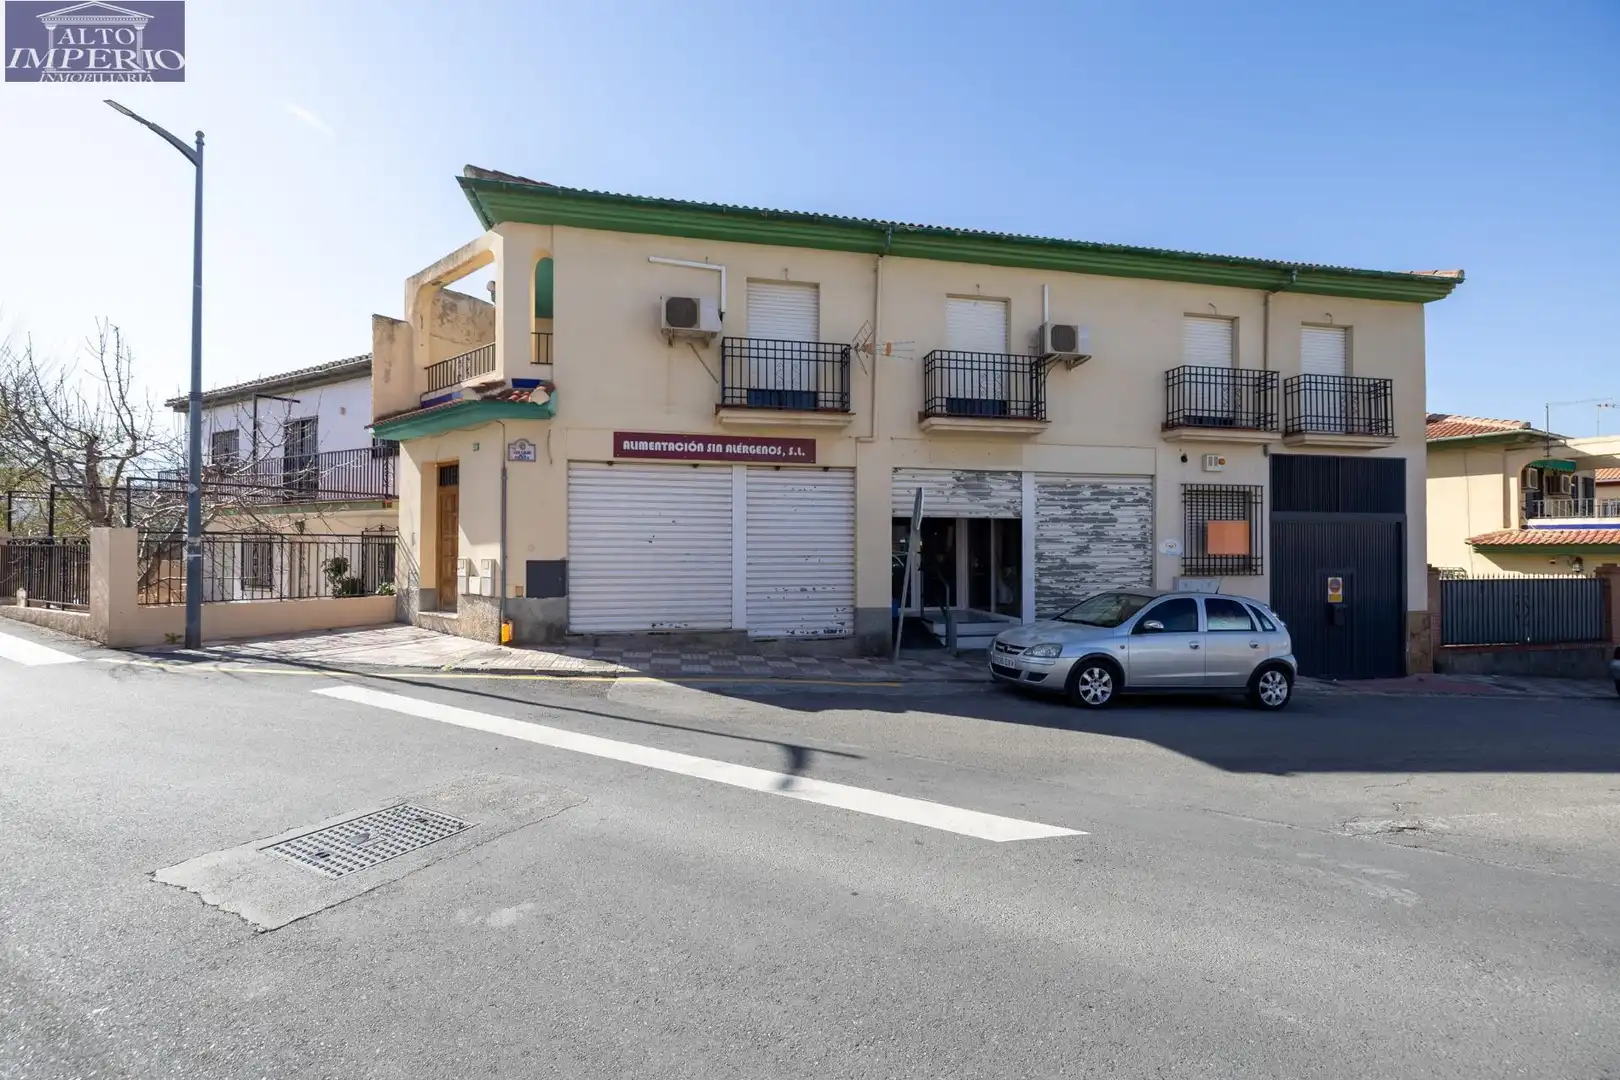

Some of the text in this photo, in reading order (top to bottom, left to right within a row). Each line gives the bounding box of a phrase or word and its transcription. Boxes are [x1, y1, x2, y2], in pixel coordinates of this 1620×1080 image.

[623, 440, 806, 457] ALIMENTACIÓN SIN ALÉRGENOS, S.L.
